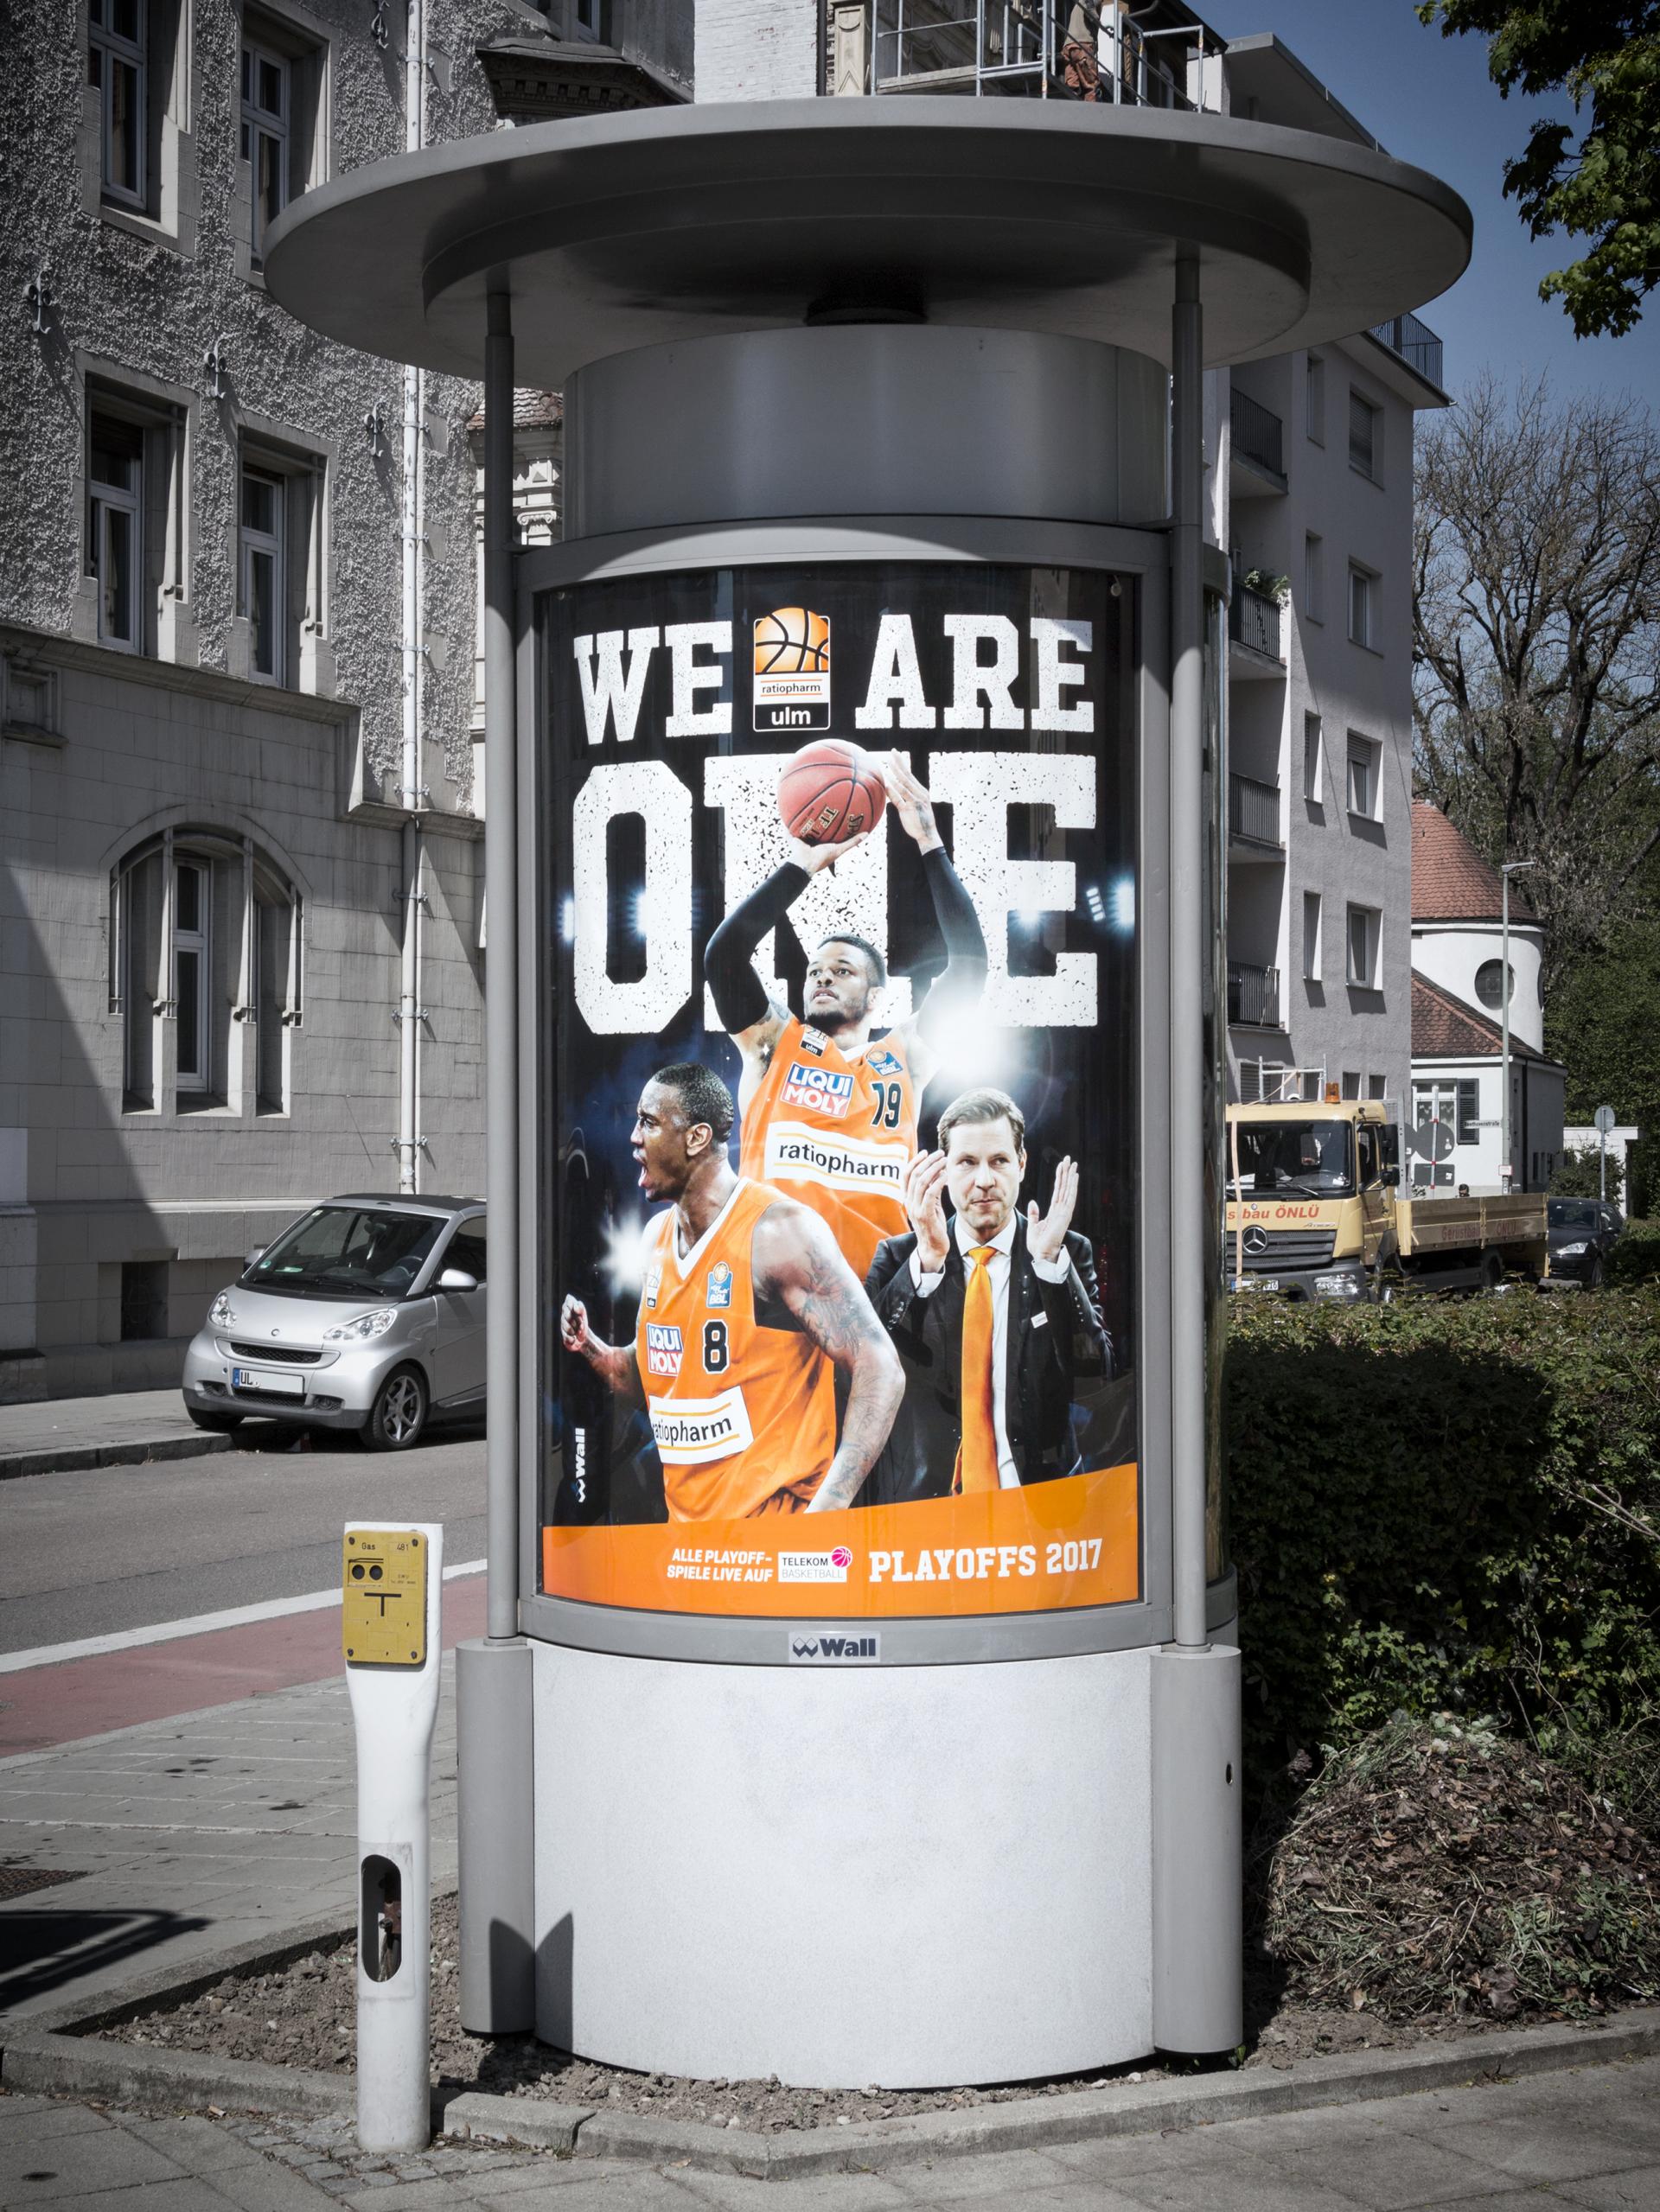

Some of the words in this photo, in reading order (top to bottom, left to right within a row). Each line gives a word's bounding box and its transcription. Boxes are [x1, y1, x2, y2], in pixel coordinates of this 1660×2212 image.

[574, 622, 732, 745] WE
[855, 614, 1094, 732] ARE
[762, 683, 820, 695] ratiopharm
[771, 706, 811, 725] ulm
[573, 751, 1098, 1035] ONE
[789, 1066, 852, 1096] LIQUI
[784, 1085, 847, 1115] MOLY
[779, 1144, 899, 1179] ratiopharm
[1275, 1204, 1319, 1219] ÖNLÜ
[649, 1327, 681, 1350] LIQUI
[703, 1320, 729, 1373] 8
[650, 1349, 682, 1374] MOLY
[672, 1548, 702, 1563] ALLE
[705, 1550, 772, 1565] PLAYOFF-
[782, 1557, 828, 1566] TELEKOM
[869, 1545, 1036, 1582] PLAYOFFS
[1046, 1538, 1102, 1574] 2017
[667, 1565, 710, 1580] SPIELE
[712, 1567, 742, 1581] LIVE
[744, 1569, 774, 1583] AUF
[782, 1569, 843, 1579] BASKETBALL
[819, 1638, 876, 1657] Wall
